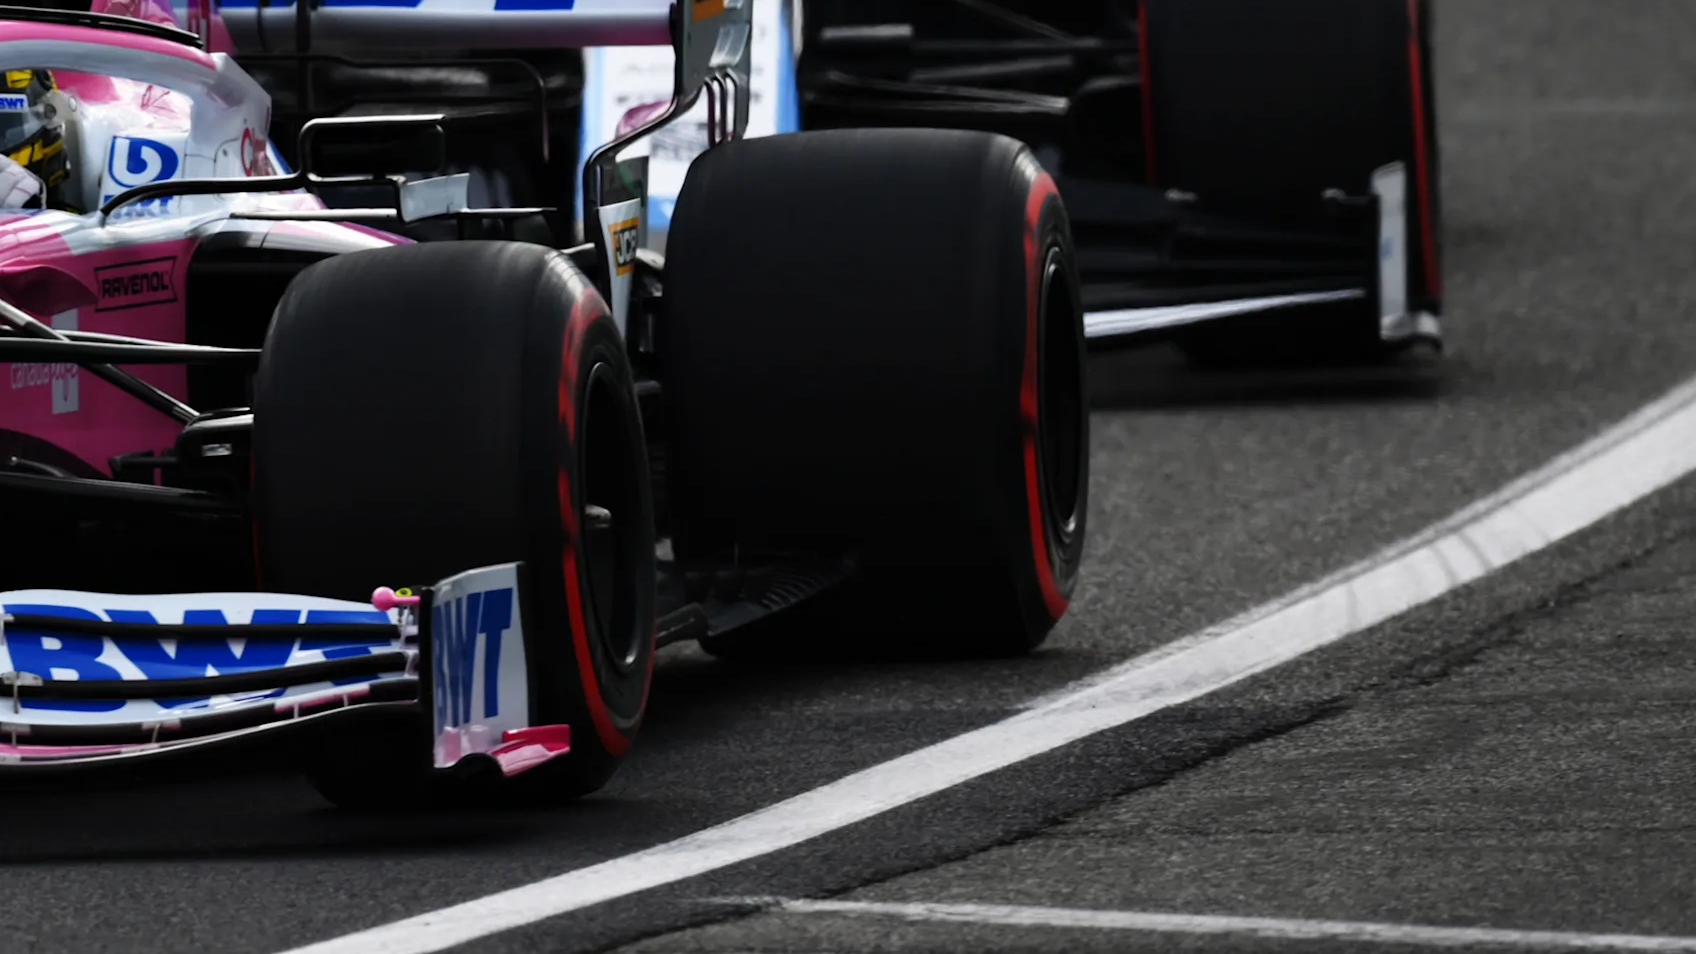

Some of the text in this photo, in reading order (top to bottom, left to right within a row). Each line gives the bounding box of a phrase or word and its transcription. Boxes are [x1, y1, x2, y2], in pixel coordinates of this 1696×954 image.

[101, 261, 169, 298] RAVENOL
[1, 603, 393, 713] BWT
[432, 587, 513, 738] BWT
